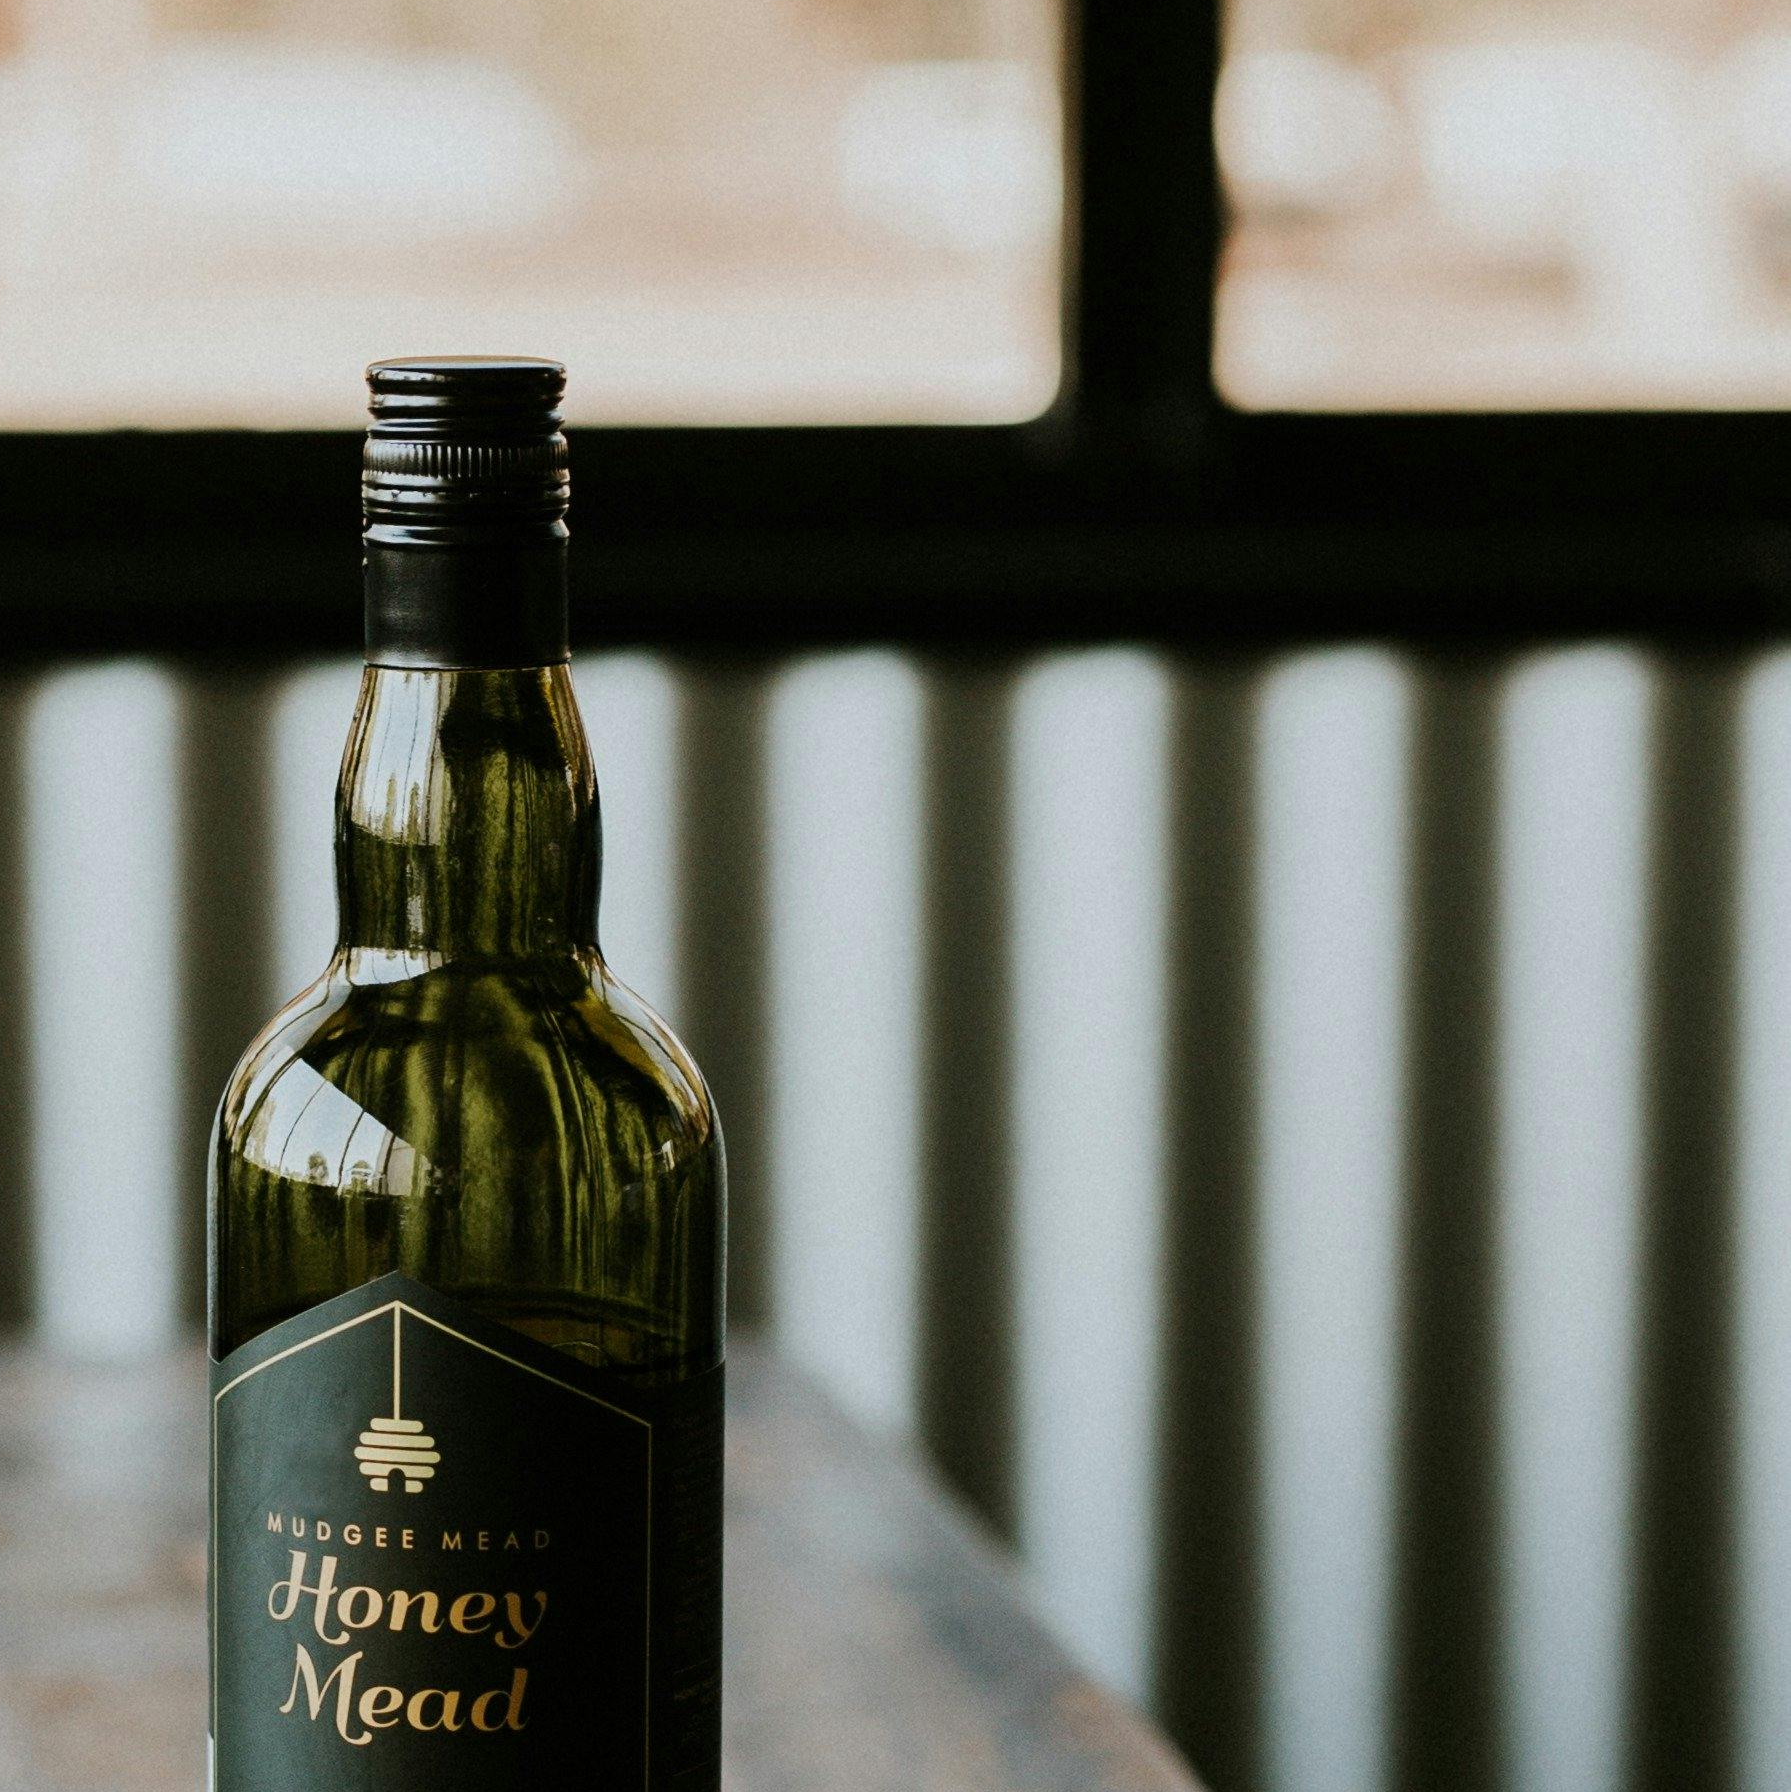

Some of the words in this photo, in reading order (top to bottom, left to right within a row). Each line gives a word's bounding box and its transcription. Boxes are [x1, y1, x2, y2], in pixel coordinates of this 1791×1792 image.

[267, 1511, 415, 1549] MUDGEE
[441, 1530, 550, 1551] MEAD
[268, 1549, 547, 1649] Honey
[278, 1643, 530, 1745] Mead
